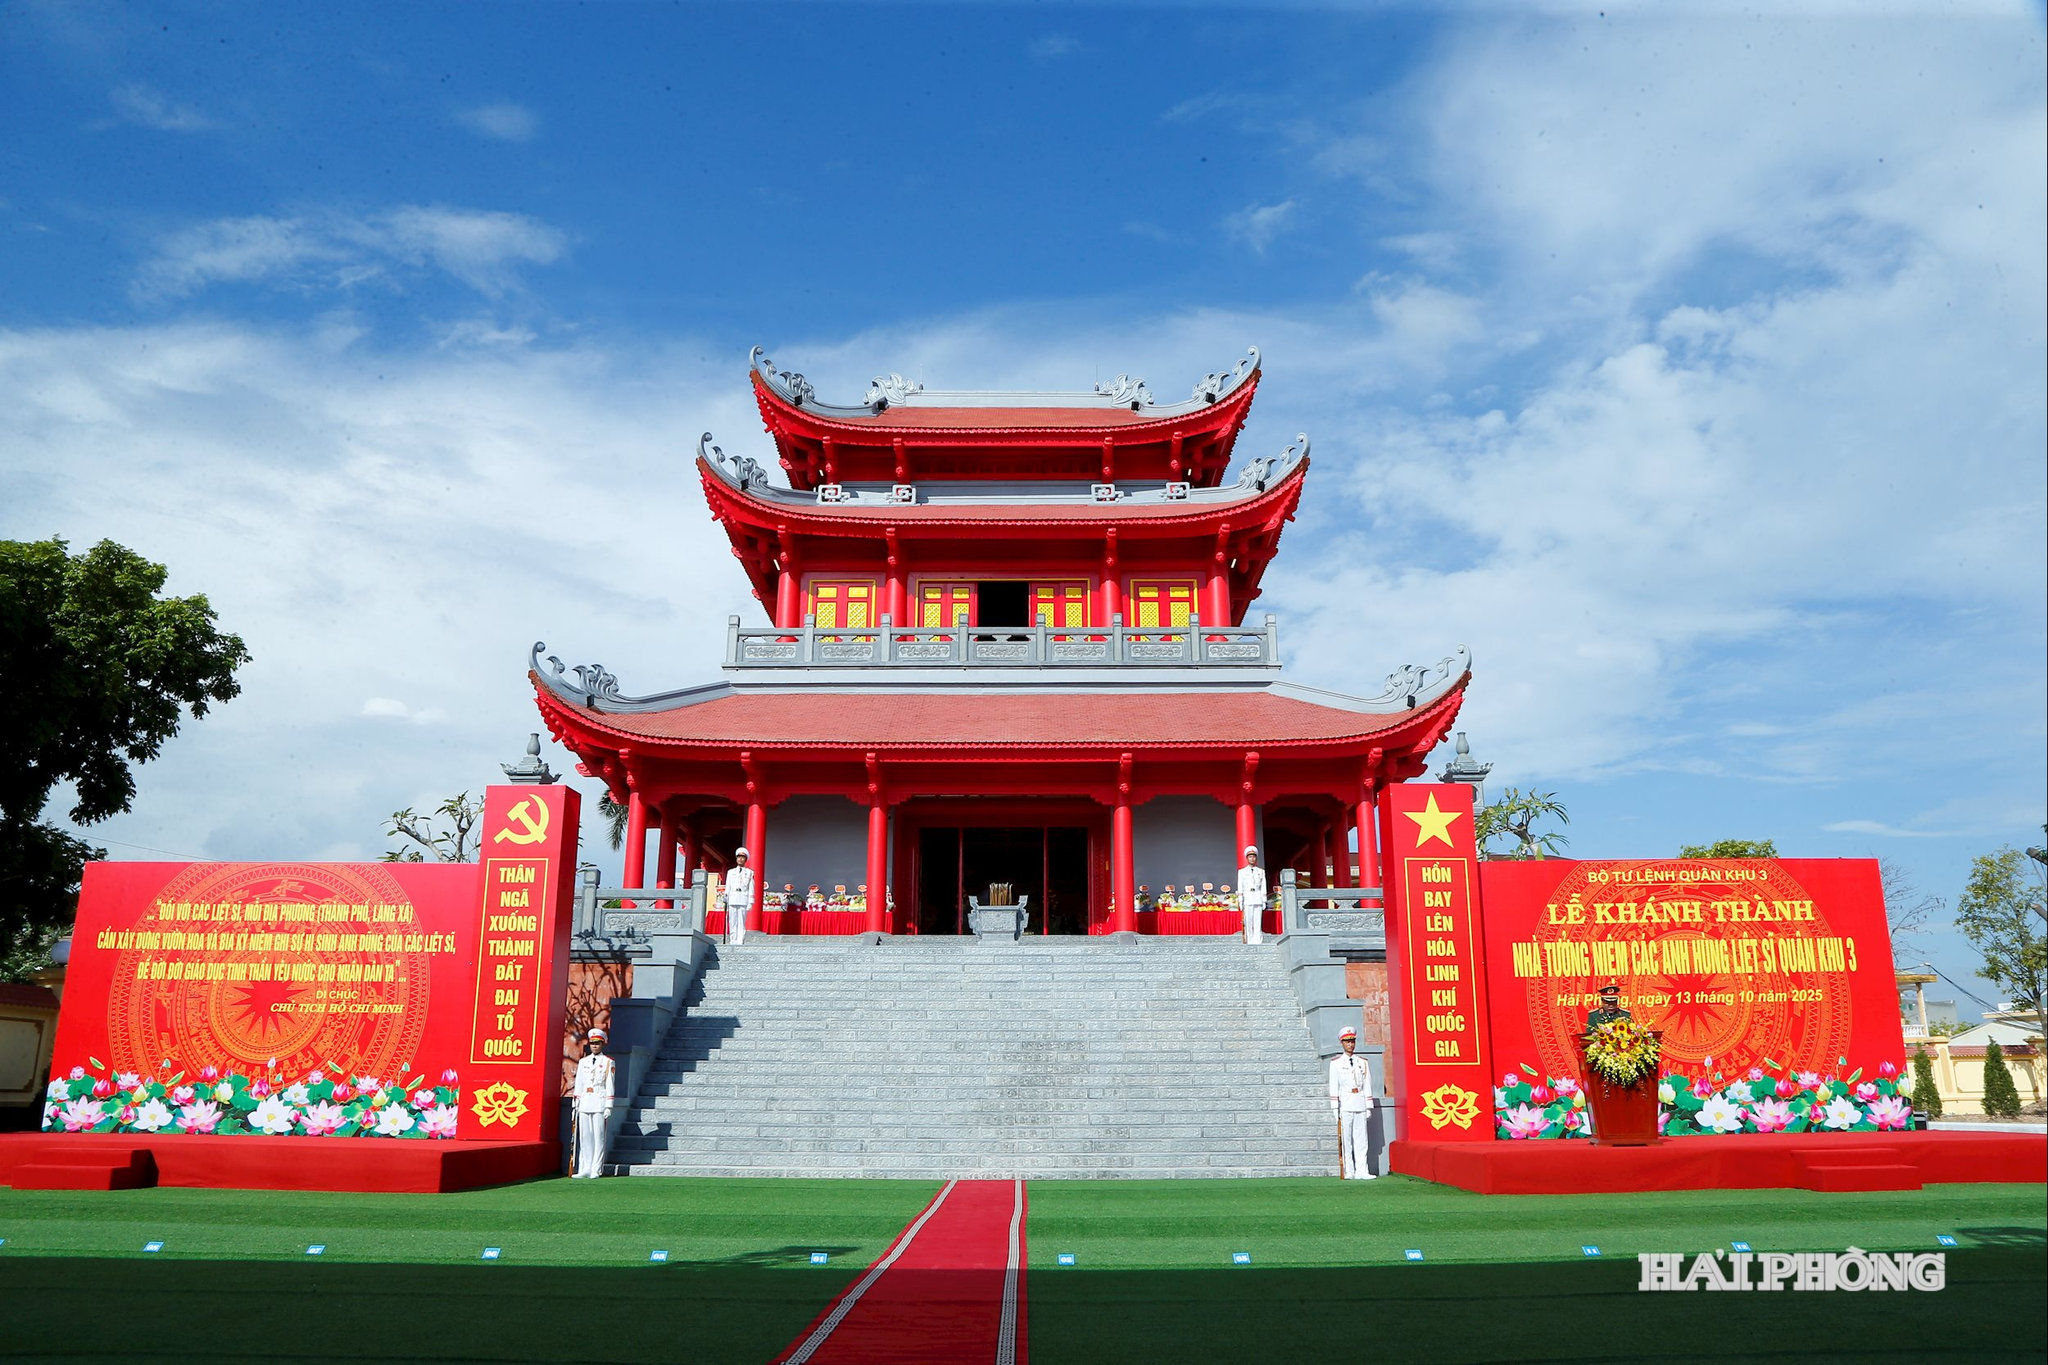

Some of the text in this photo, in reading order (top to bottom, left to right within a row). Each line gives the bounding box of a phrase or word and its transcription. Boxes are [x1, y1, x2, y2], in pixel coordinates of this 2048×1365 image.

[499, 864, 535, 883] THÂN
[1422, 862, 1452, 883] HỒN
[1588, 868, 1768, 885] BỘ TƯ LỆNH QUÂN KHU 3
[501, 890, 529, 907] NGÃ
[1424, 891, 1452, 907] BAY
[176, 899, 191, 920] VỚI
[192, 900, 210, 920] CÁC
[211, 900, 230, 925] LIỆT
[230, 901, 242, 922] SĨ,
[263, 904, 278, 925] ĐỊA
[279, 903, 316, 922] PHƯƠNG
[317, 901, 349, 923] (THÀNH
[350, 899, 371, 923] PHỐ,
[372, 901, 397, 923] LÀNG
[397, 901, 413, 923] XÃ)
[1547, 893, 1815, 925] LỄ KHÁNH THÀNH
[489, 911, 537, 932] XUỐNG
[1426, 912, 1453, 932] LÊN
[97, 926, 456, 956] CẦN XÂY DỰNG VƯỜN HOA VÀ BIA KỶ NIỆM GHI SỰ HI SINH ANH DŨNG CỦA CÁC LIỆT SĨ,
[489, 936, 534, 956] THÀNH
[1426, 937, 1456, 956] HÓA
[1512, 931, 1857, 984] NHÀ TƯỞNG NIỆM CÁC ANH HÙNG LIỆT SĨ QUÂN KHU 3
[151, 958, 167, 980] ĐỜI
[168, 958, 184, 980] ĐỜI
[184, 959, 206, 980] GIÁO
[206, 963, 225, 984] DỤC
[227, 963, 247, 981] TINH
[249, 956, 272, 981] THẦN
[273, 960, 291, 981] YÊU
[291, 959, 317, 981] NƯỚC
[317, 964, 336, 981] CHO
[337, 961, 363, 982] NHÂN
[363, 961, 384, 982] DÂN
[496, 961, 523, 981] ĐẤT
[1426, 964, 1459, 981] LINH
[316, 988, 359, 999] DI CHÚC
[495, 990, 518, 1006] ĐAI
[1432, 987, 1456, 1006] KHÍ
[1557, 994, 1580, 1007] Hải
[1637, 993, 1672, 1006] ngày
[1676, 992, 1691, 1004] 13
[1695, 991, 1734, 1005] tháng
[1739, 991, 1755, 1003] 10
[1758, 991, 1787, 1002] năm
[1791, 989, 1823, 1002] 2025
[270, 1000, 404, 1014] CHỦ TỊCH HỒ CHÍ MINH
[497, 1008, 515, 1031] TỔ
[1426, 1010, 1465, 1032] QUỐC
[484, 1036, 522, 1057] QUỐC
[1435, 1040, 1460, 1057] GIA
